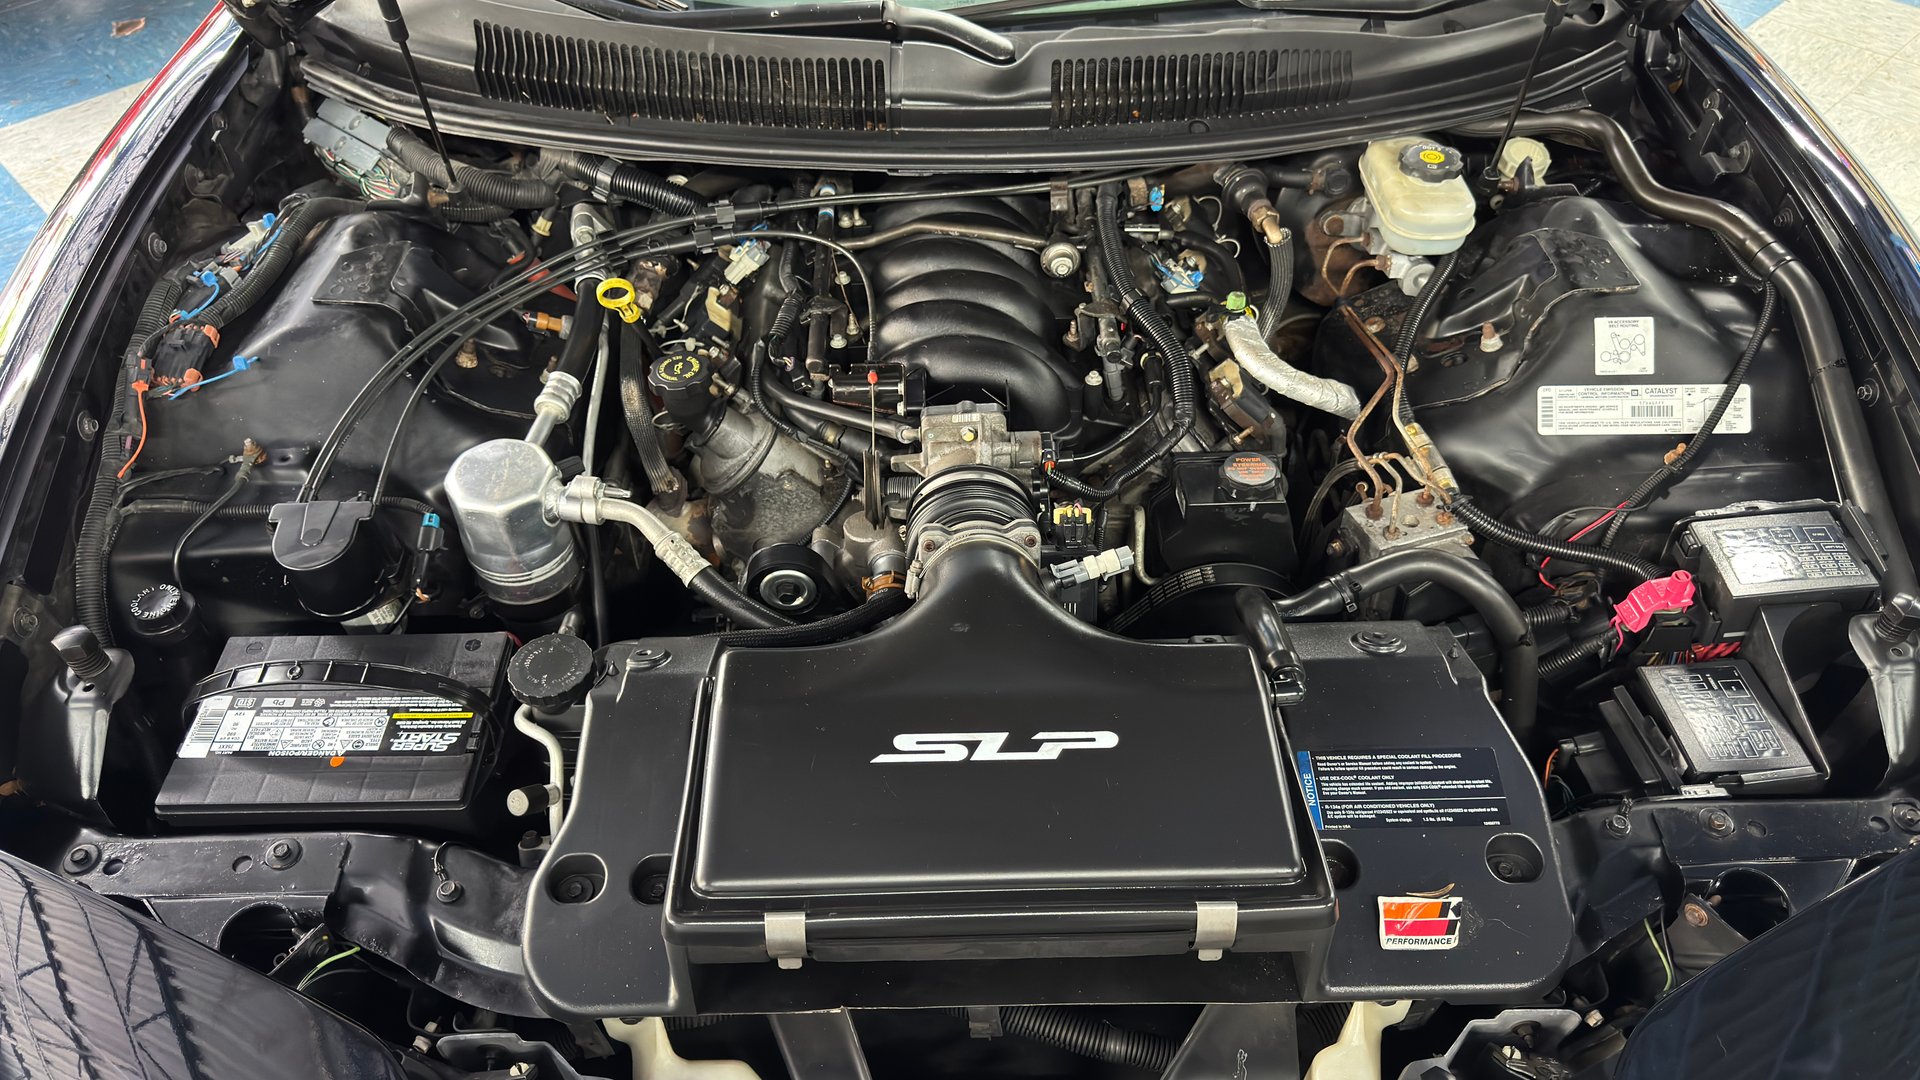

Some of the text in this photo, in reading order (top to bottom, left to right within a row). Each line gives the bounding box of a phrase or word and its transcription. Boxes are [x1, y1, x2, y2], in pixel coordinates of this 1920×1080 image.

[683, 356, 700, 379] ENGINE OIL
[159, 584, 180, 596] ONLY
[395, 732, 461, 743] START
[390, 742, 448, 752] SUPER
[869, 731, 1119, 763] SLP
[1303, 773, 1316, 806] NOTICE
[1386, 937, 1452, 945] PERFORMANCE
